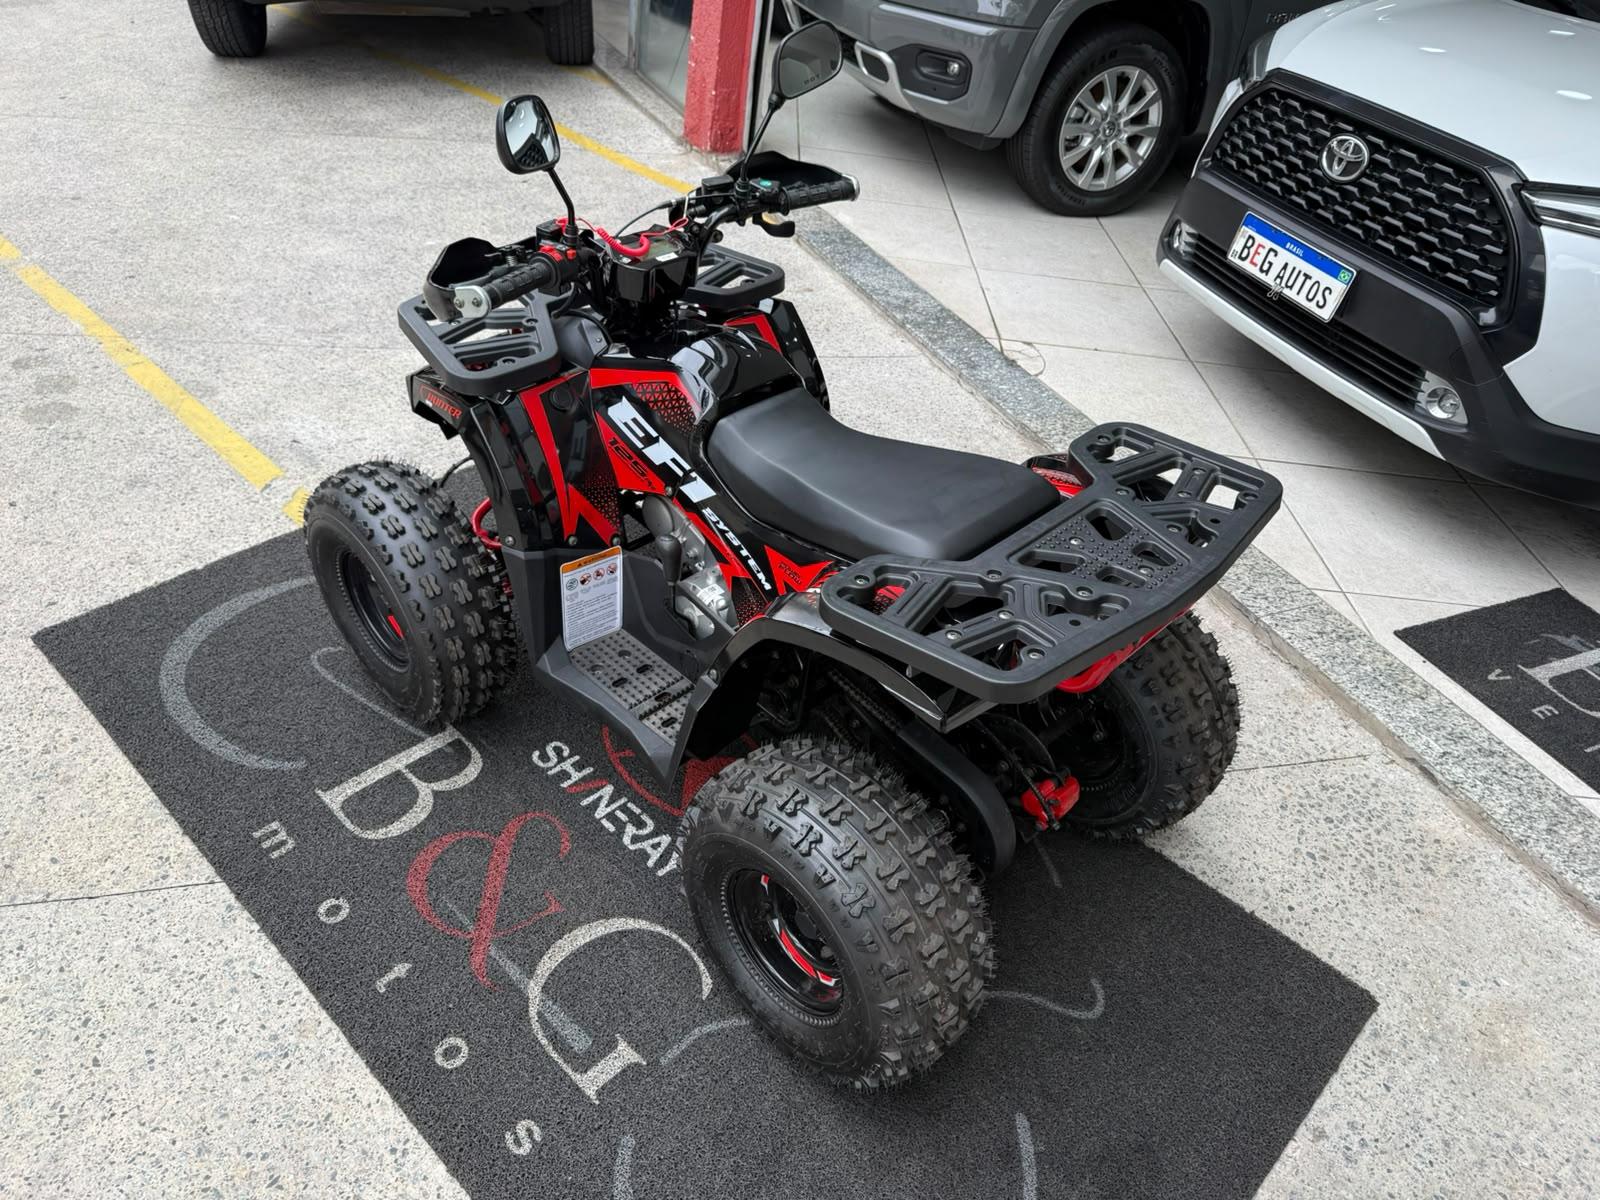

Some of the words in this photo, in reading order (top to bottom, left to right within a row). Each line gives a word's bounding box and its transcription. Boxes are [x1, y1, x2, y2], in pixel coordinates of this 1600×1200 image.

[1237, 234, 1279, 276] BEG
[1273, 261, 1333, 310] AUTOS
[1285, 241, 1304, 258] BRASIL
[607, 395, 717, 504] EFI
[608, 436, 651, 483] 125
[702, 507, 772, 591] SYSTEM
[531, 740, 684, 879] SHINERAY
[253, 820, 541, 1155] motos
